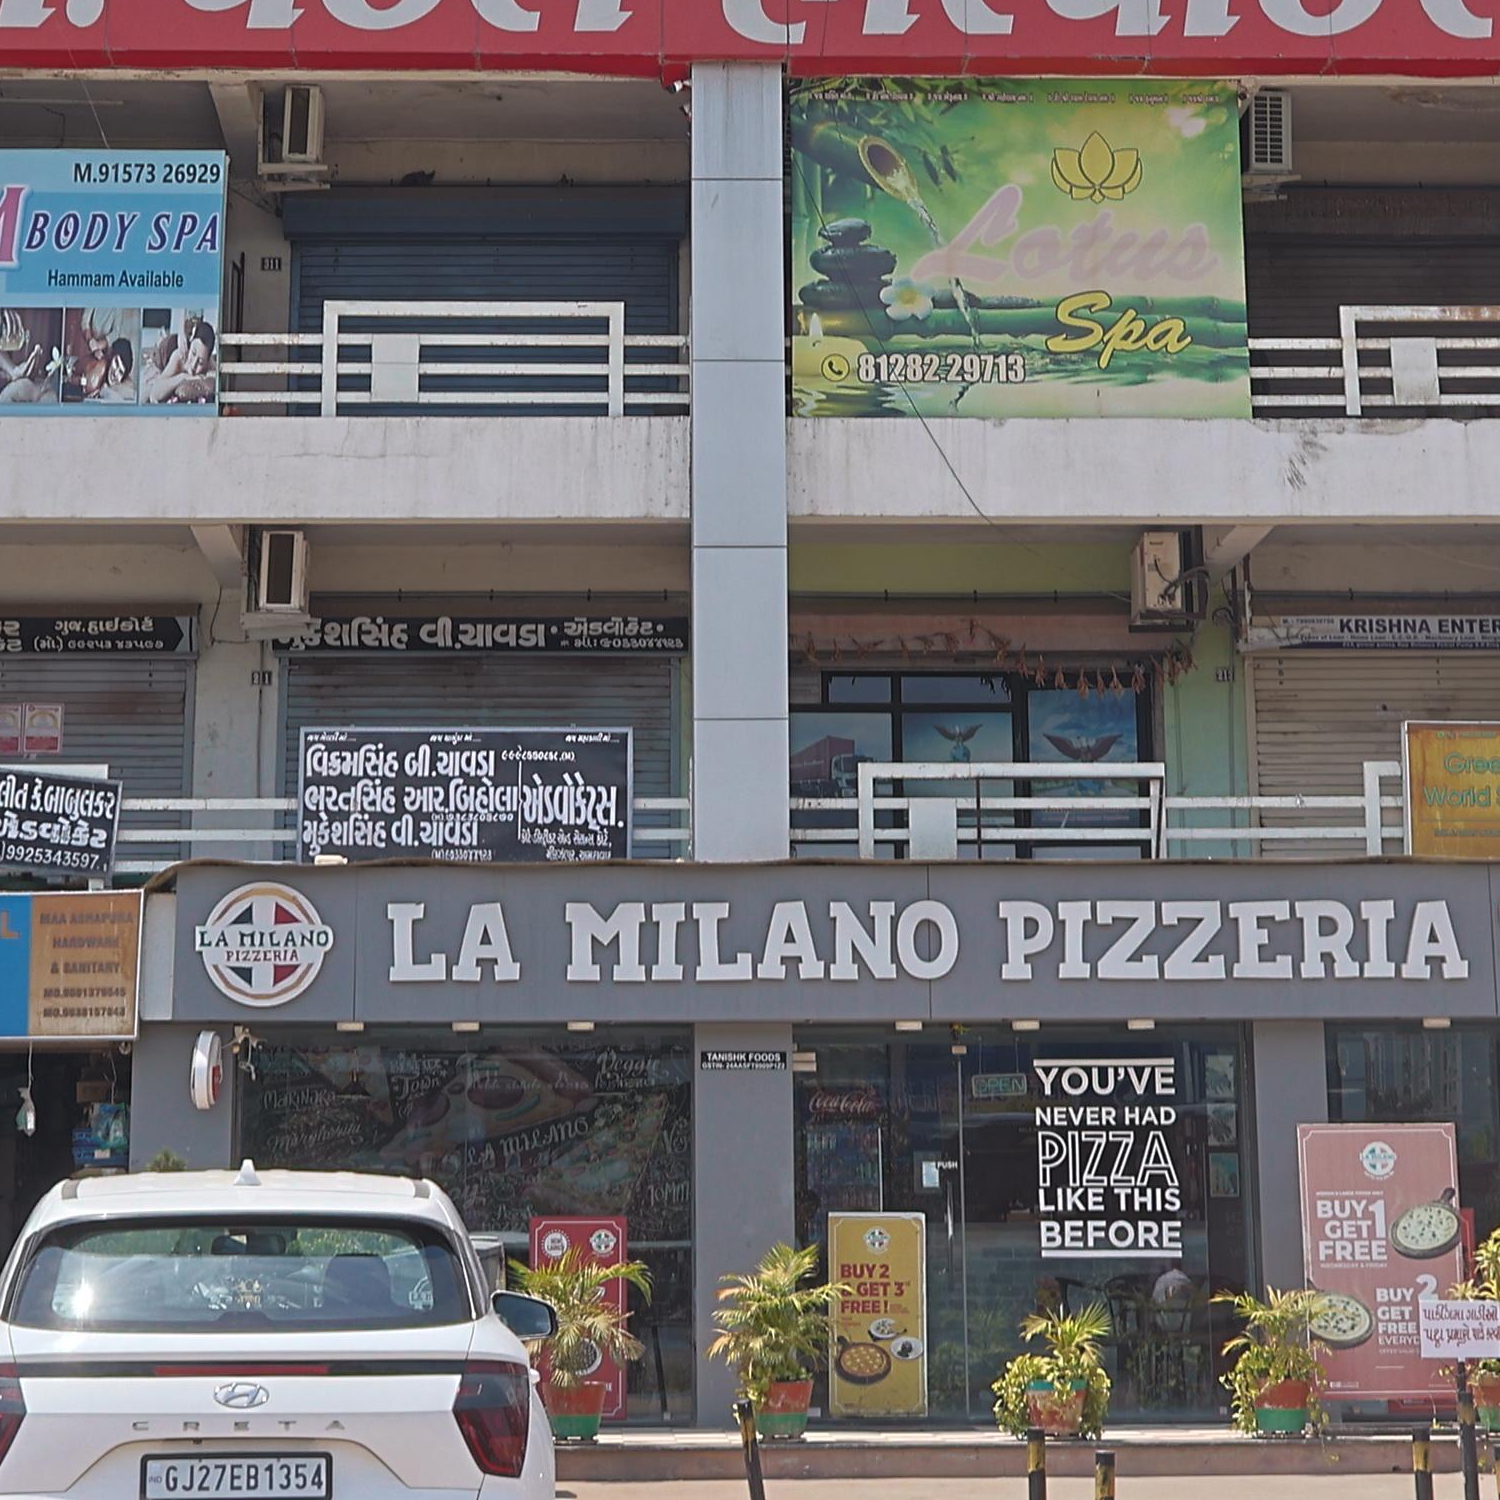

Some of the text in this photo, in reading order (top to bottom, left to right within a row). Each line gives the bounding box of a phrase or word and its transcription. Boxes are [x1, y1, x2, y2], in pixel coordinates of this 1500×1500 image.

[73, 162, 220, 184] M.91573 26929
[24, 211, 220, 253] BODY SPA
[910, 183, 1220, 283] Lotus
[47, 269, 184, 288] Hammam Available
[1044, 290, 1193, 369] Spa
[857, 353, 1026, 384] 81282 29713
[1339, 618, 1431, 634] KRISHNA
[1423, 785, 1491, 806] World
[198, 928, 331, 949] LA MILANO
[387, 900, 1469, 982] LA MILANO PIZZERIA
[225, 948, 300, 963] PIZZERIA
[707, 1052, 781, 1061] TANISHK FOODS
[976, 1077, 1025, 1093] OPEN
[1035, 1106, 1176, 1126] NEVER HAD
[937, 1160, 958, 1171] PUSH
[1038, 1131, 1179, 1187] PIZZA
[1039, 1188, 1181, 1212] LIKE THIS
[1316, 1199, 1387, 1239] BUY 1
[1040, 1220, 1182, 1248] BEFORE
[1324, 1220, 1372, 1239] GET
[1319, 1241, 1388, 1261] FREE
[841, 1264, 890, 1278] BUY 2
[857, 1282, 890, 1297] GET
[1376, 1274, 1438, 1302] BUY 2
[1377, 1305, 1413, 1320] GET
[1378, 1322, 1418, 1334] FREE
[132, 1419, 346, 1432] CRETA
[164, 1457, 325, 1493] GJ27EB1354
